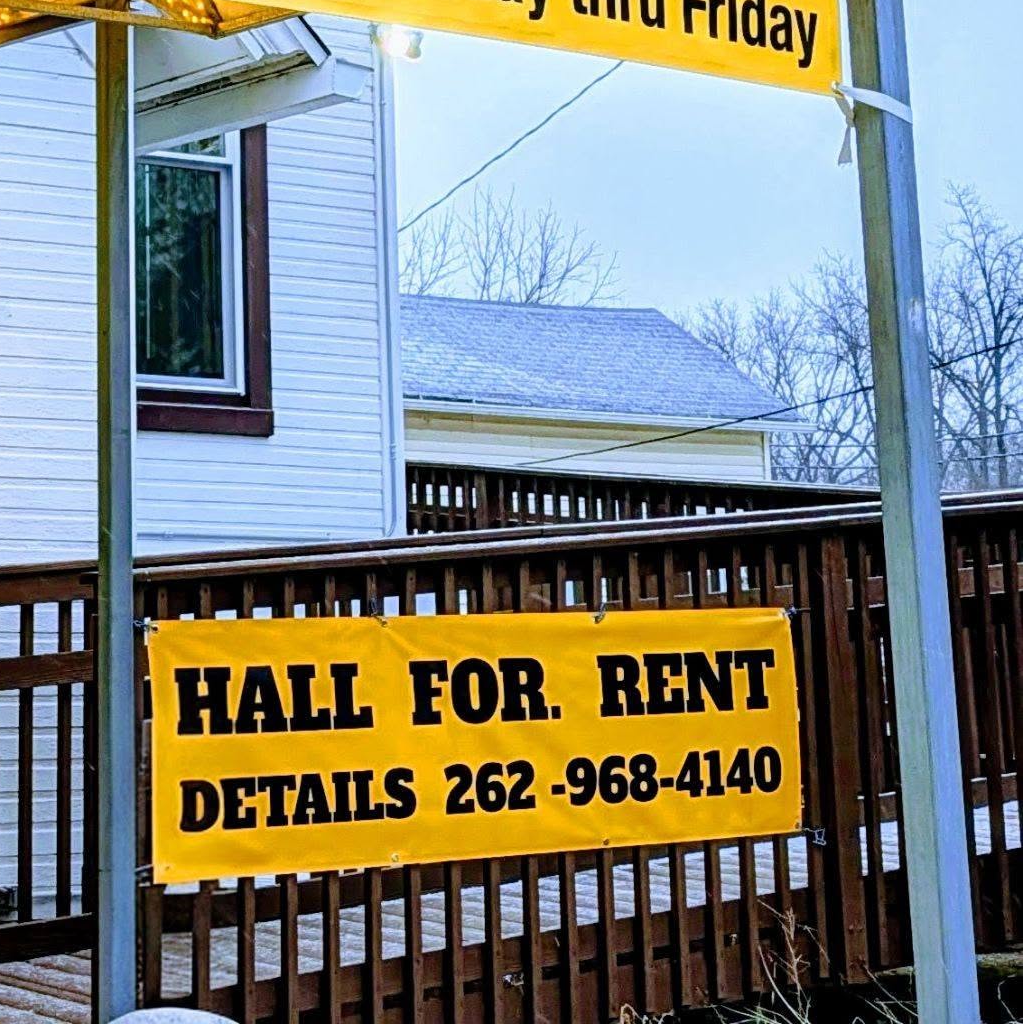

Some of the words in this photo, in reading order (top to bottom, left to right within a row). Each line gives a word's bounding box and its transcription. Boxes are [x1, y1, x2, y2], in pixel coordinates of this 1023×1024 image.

[174, 662, 374, 736] HALL
[408, 657, 562, 726] FOR.
[596, 648, 776, 718] RENT
[179, 767, 417, 833] DETAILS
[443, 759, 536, 815] 262
